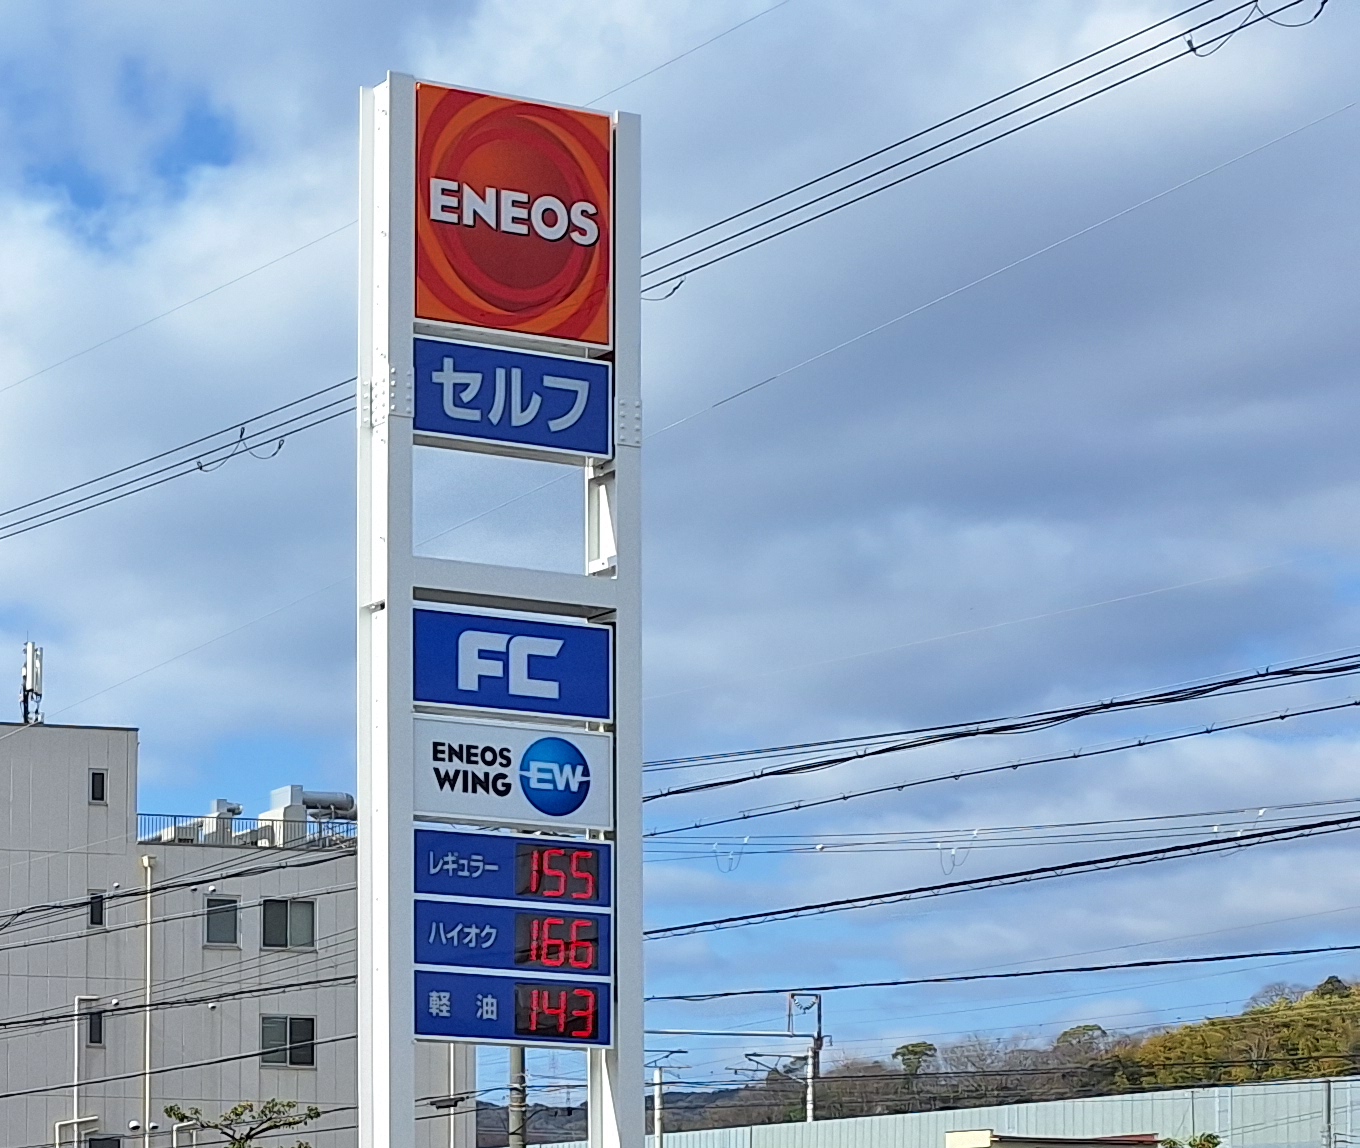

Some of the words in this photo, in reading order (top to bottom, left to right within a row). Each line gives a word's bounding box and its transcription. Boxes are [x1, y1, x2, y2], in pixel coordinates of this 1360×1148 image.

[429, 177, 600, 247] ENEOS
[431, 357, 590, 433] セルフ
[457, 630, 565, 699] FC
[432, 741, 512, 768] ENEOS
[528, 760, 586, 793] EW
[433, 767, 512, 797] WING
[428, 850, 499, 878] レギュラー
[529, 847, 596, 900] 155
[428, 921, 498, 949] ハイオク
[529, 918, 595, 969] 166
[428, 990, 498, 1021] 軽油
[529, 988, 596, 1038] 143
